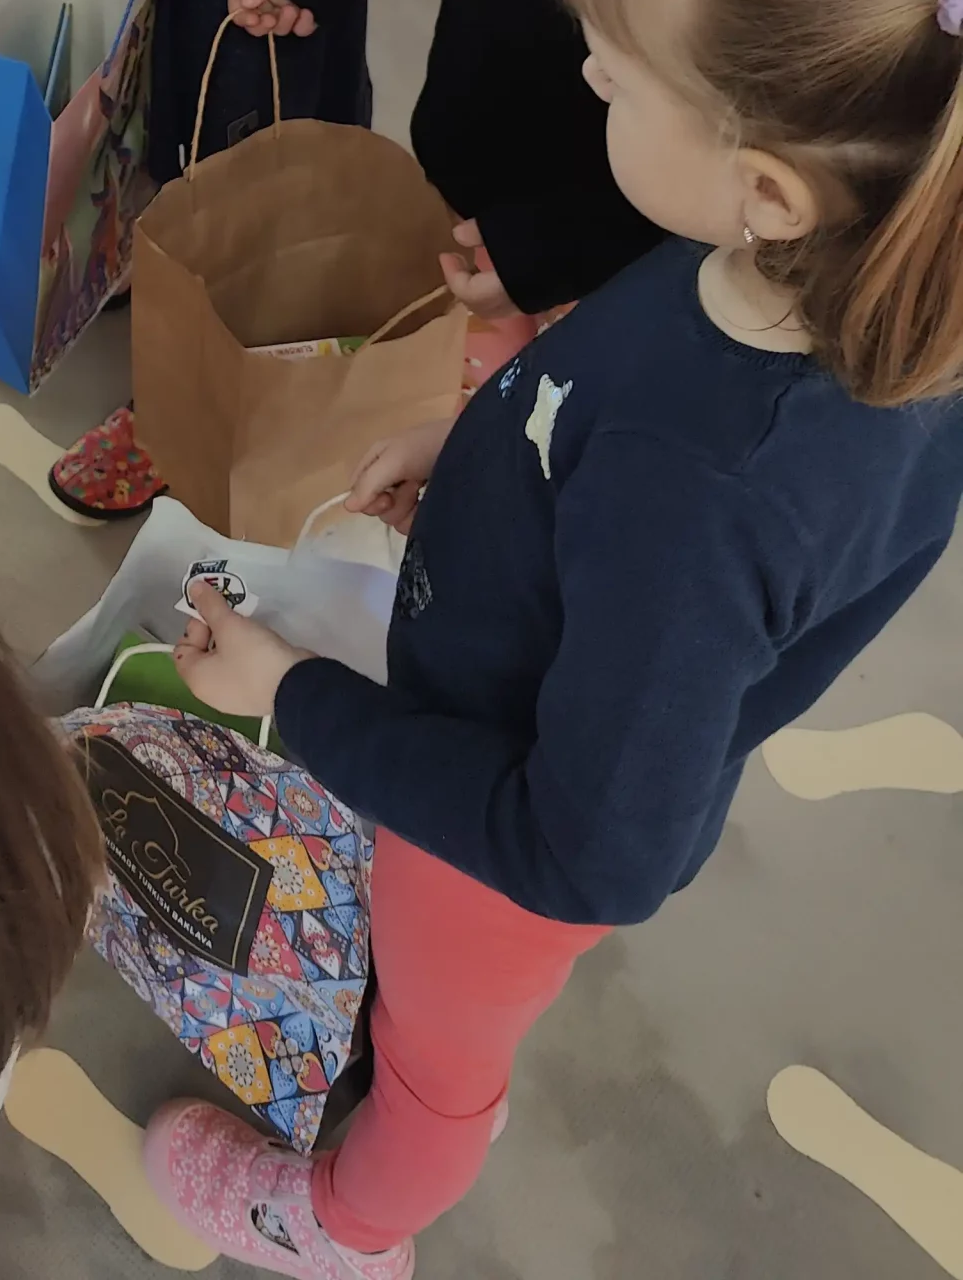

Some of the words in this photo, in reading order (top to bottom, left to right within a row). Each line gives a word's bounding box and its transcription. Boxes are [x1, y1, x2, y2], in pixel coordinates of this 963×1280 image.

[105, 835, 137, 874] NDMADE
[138, 870, 171, 915] TURKISH
[171, 910, 214, 950] BAKLAVA
[131, 840, 220, 935] Turka
